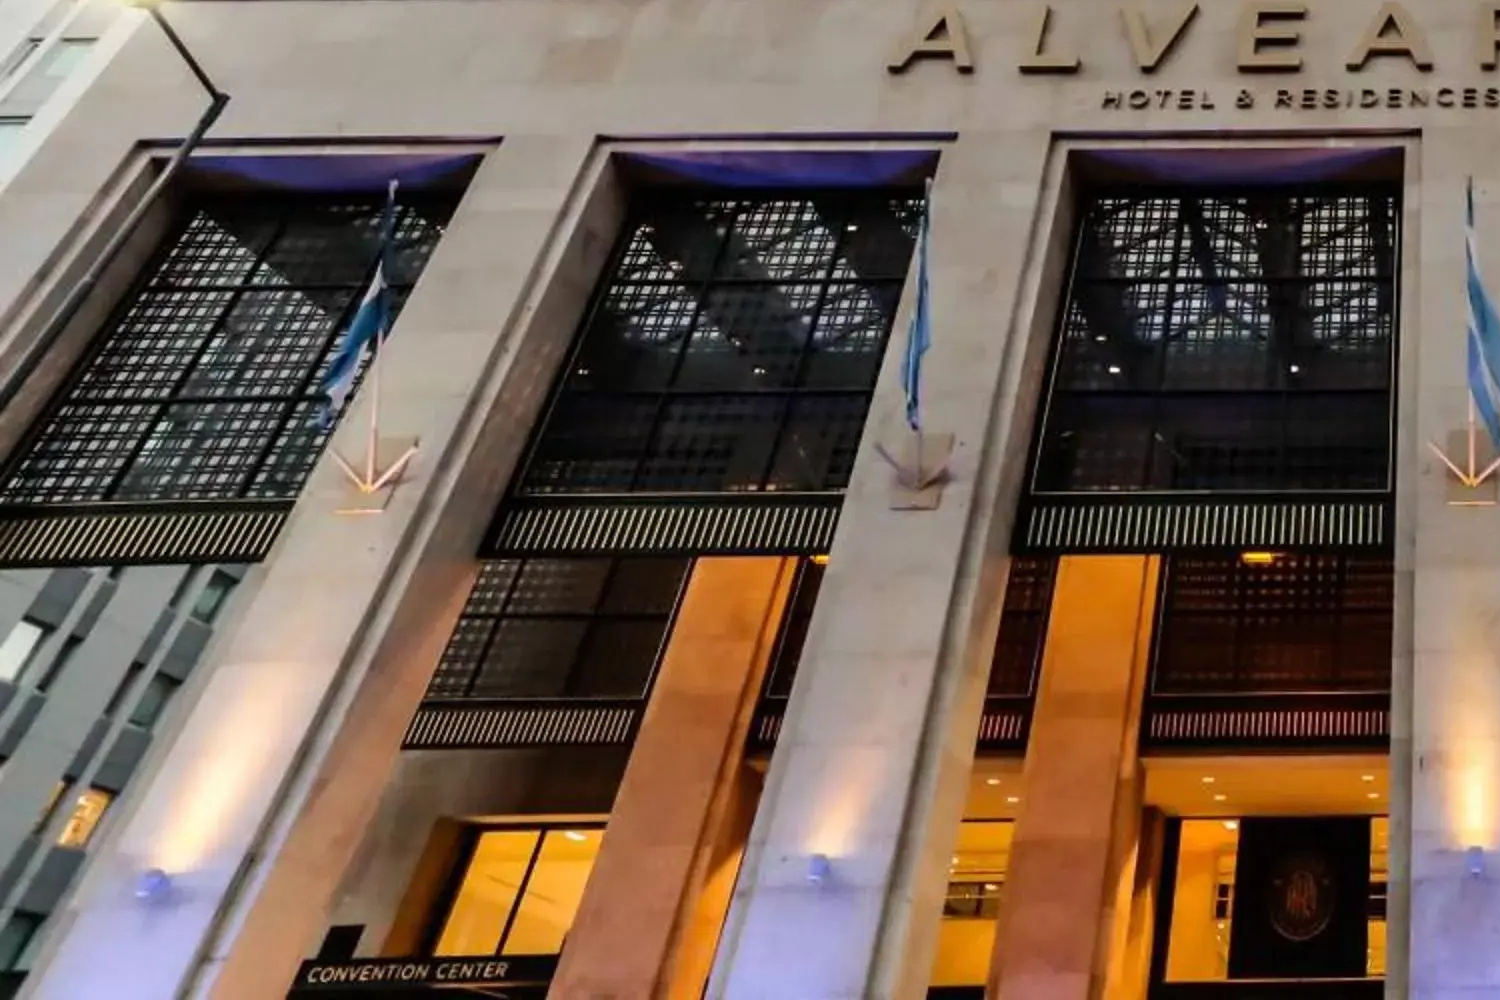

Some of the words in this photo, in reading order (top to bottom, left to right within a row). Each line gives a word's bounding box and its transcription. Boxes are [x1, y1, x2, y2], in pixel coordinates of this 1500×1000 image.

[1102, 89, 1216, 110] HOTEL
[1236, 88, 1255, 109] &
[1274, 87, 1498, 109] RESIDENCES
[307, 964, 431, 983] CONVENTION
[435, 961, 509, 980] CENTER
